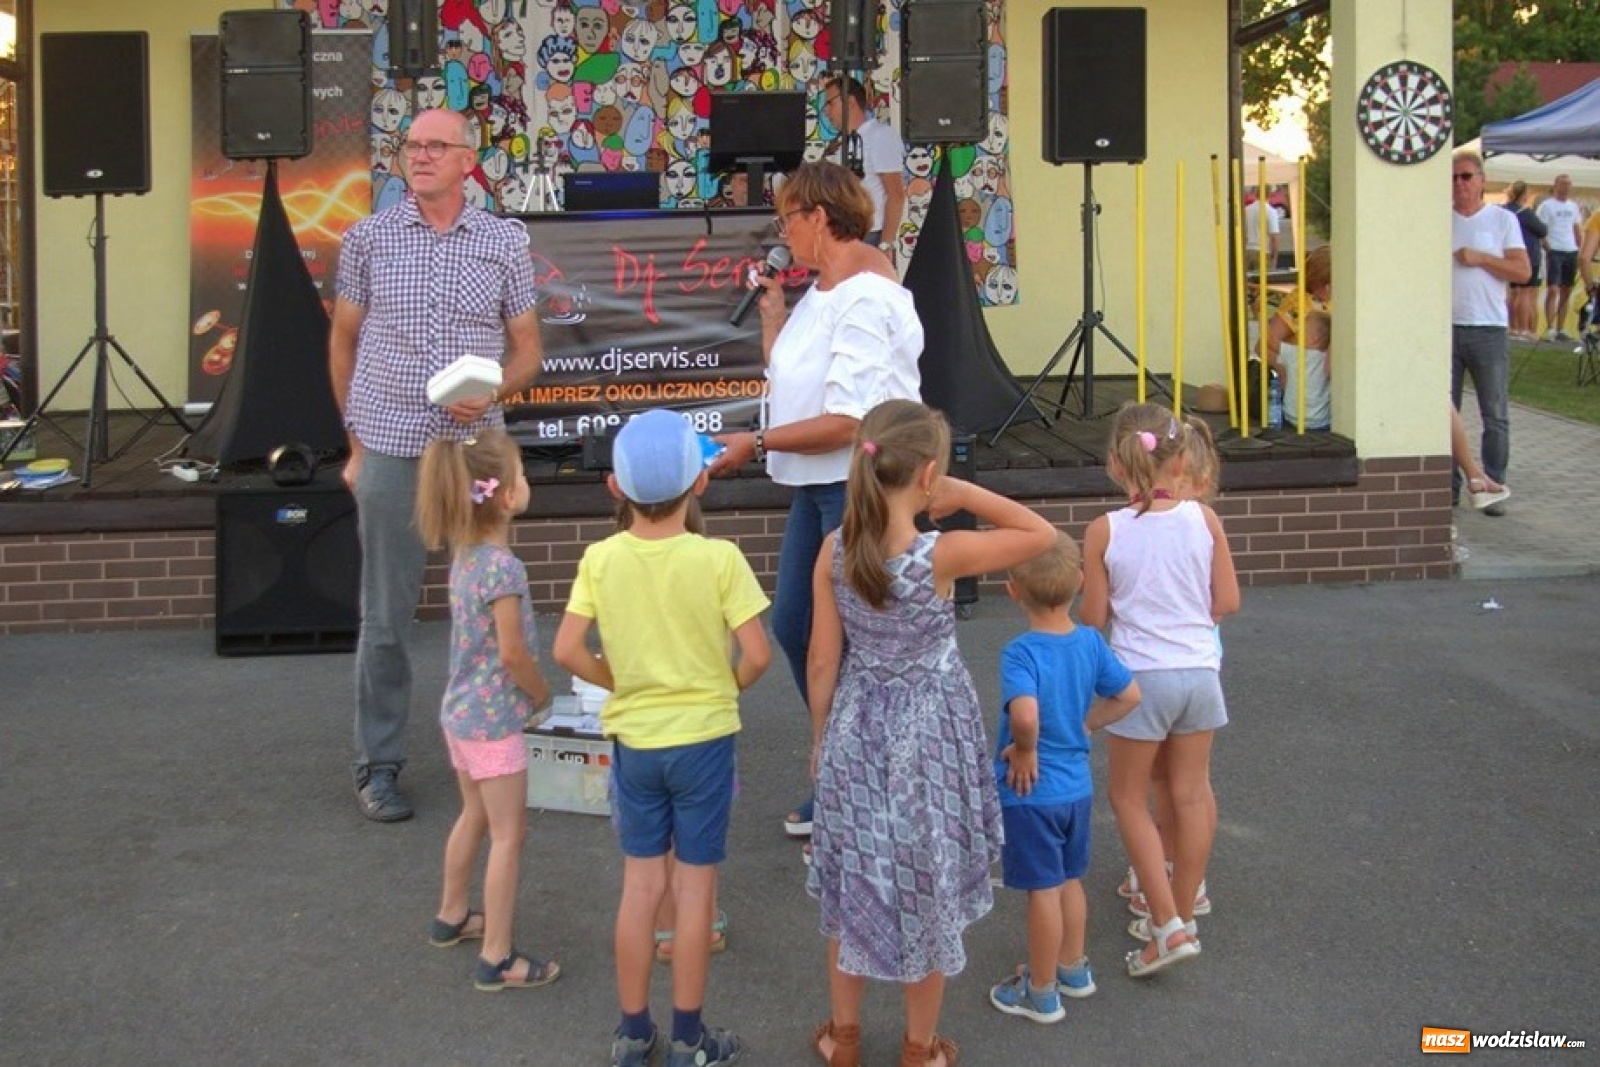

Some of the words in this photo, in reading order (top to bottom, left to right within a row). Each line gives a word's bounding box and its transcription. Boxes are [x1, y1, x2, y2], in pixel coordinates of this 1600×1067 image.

[541, 346, 719, 375] www.djservis.eu
[529, 386, 599, 404] IMPREZ
[537, 419, 569, 438] tel.
